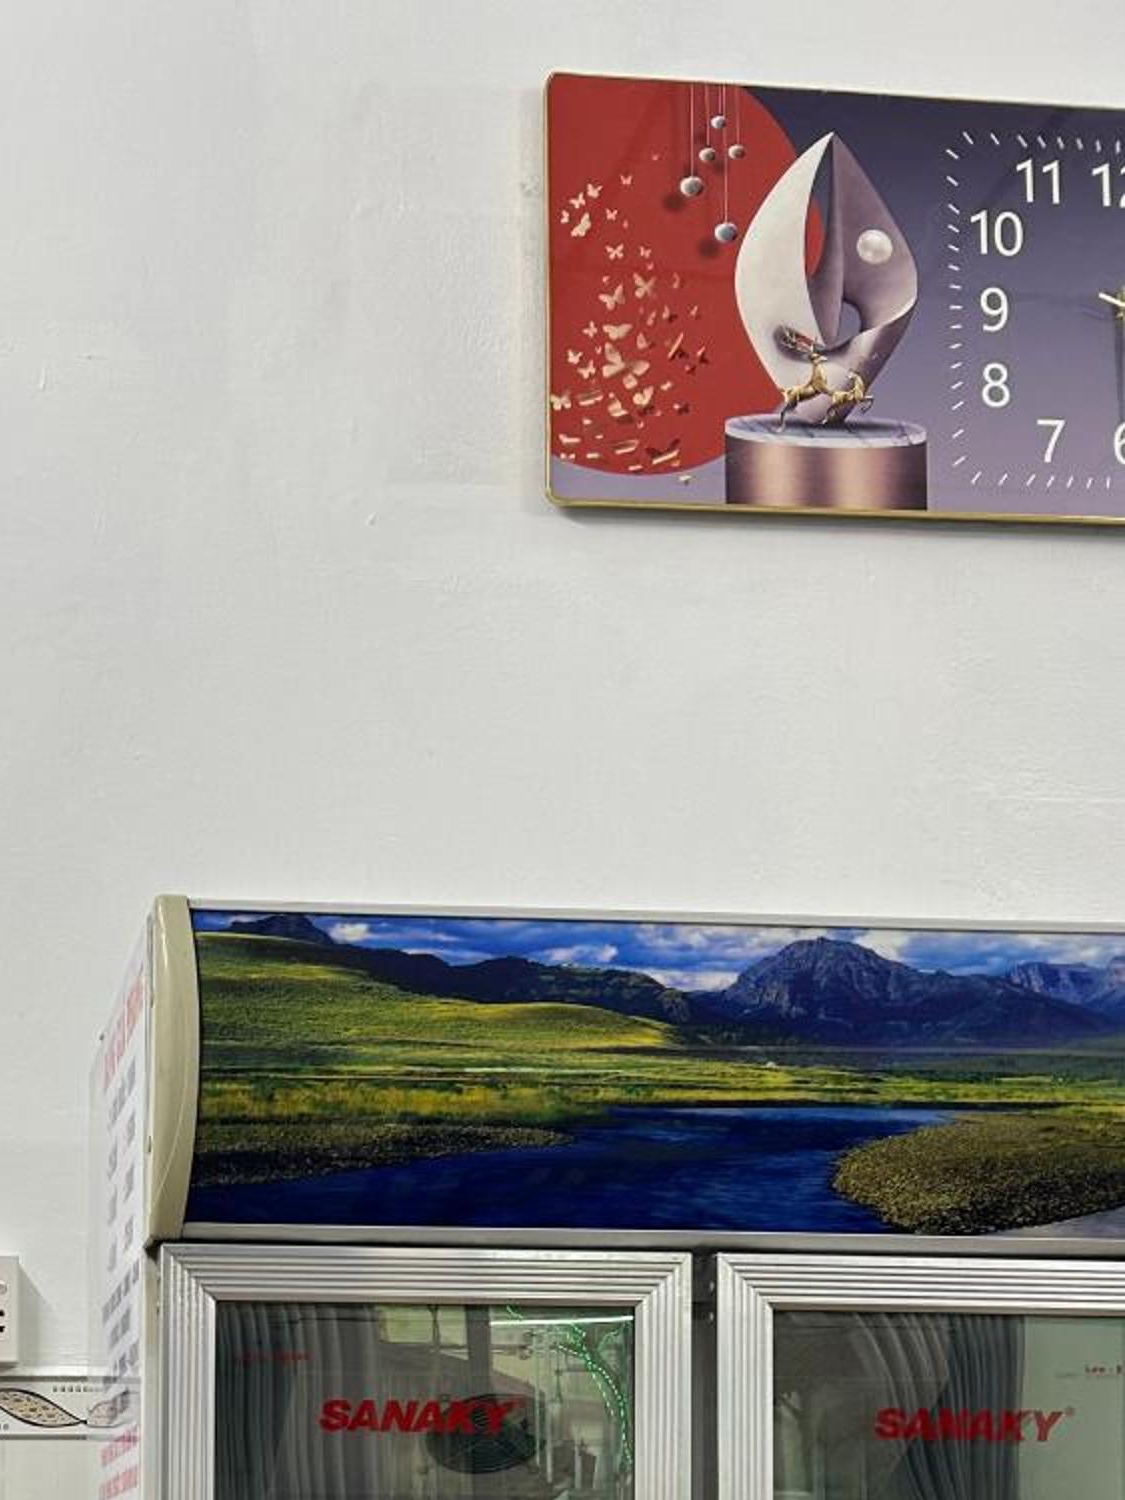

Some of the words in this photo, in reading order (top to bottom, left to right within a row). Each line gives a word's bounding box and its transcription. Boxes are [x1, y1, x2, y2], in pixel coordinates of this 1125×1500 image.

[1016, 159, 1062, 205] 11
[1092, 163, 1125, 208] 1
[970, 211, 1024, 257] 10
[980, 286, 1009, 332] 9
[981, 363, 1011, 407] 8
[1036, 419, 1067, 464] 7
[320, 1398, 513, 1433] SANAKY
[874, 1407, 1063, 1443] SANAKY
